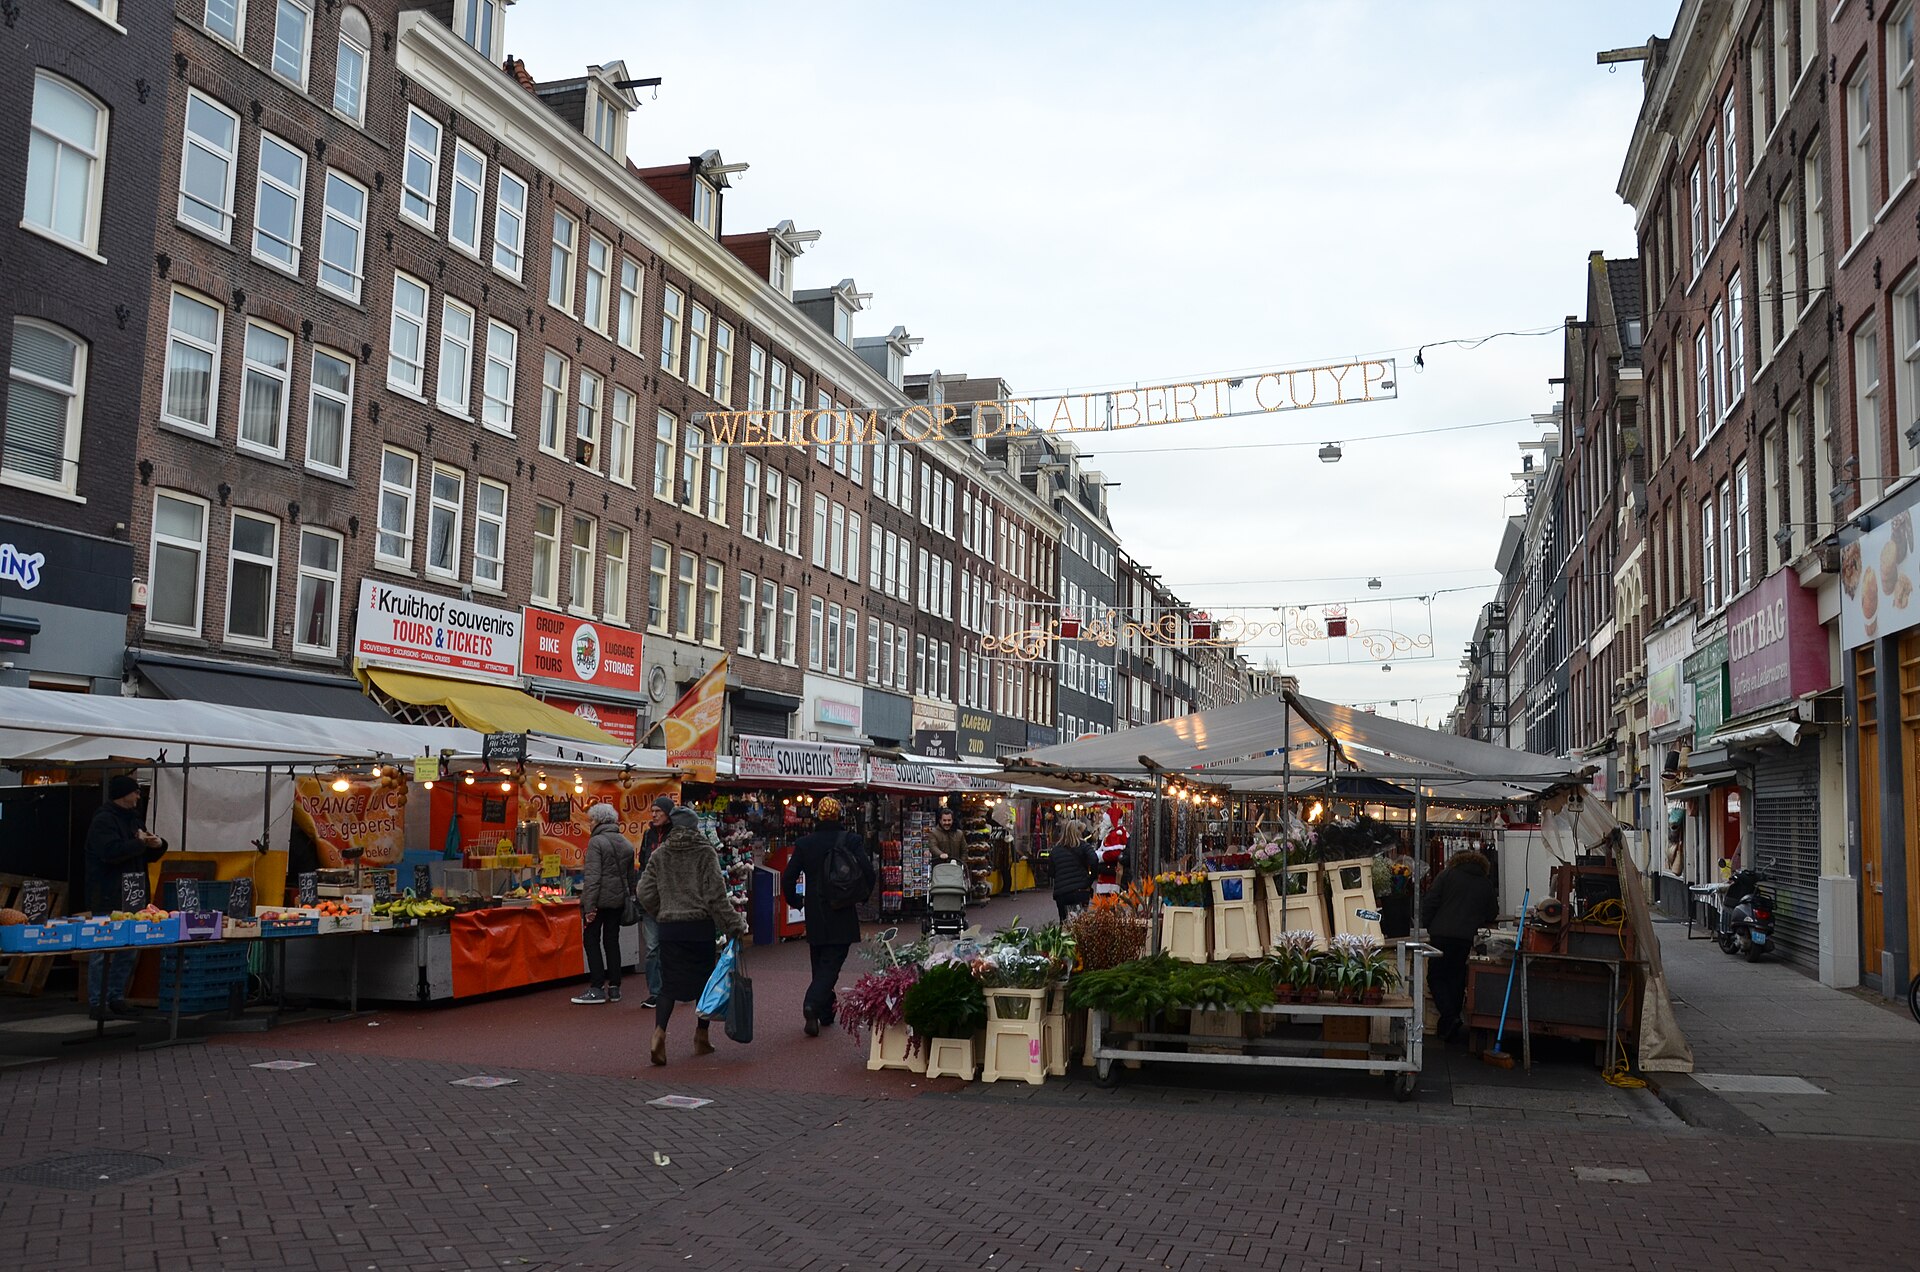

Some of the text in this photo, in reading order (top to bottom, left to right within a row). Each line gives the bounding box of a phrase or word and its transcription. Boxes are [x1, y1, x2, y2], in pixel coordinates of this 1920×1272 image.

[705, 360, 1386, 446] WELKOM OP DE ALBERT CUYP
[379, 588, 515, 638] Kruithof souvenirs
[536, 616, 564, 635] GROUP
[1731, 614, 1756, 663] CITY
[1758, 597, 1787, 651] BAG
[393, 619, 493, 657] TOURS & TICKETS
[539, 636, 560, 654] BIKE
[363, 643, 391, 655] SOUVENIRS
[604, 641, 635, 659] LUGGAGE
[534, 654, 563, 673] TOURS
[603, 659, 635, 677] STORAGE
[961, 713, 992, 732] SLAGERIJ
[926, 746, 938, 756] Pho
[968, 738, 984, 754] ZUID
[744, 738, 775, 759] Kruithof
[777, 745, 833, 776] souvenirs
[836, 747, 860, 765] Kruithof
[302, 796, 365, 814] ORANGE
[341, 815, 397, 841] geperst
[541, 821, 582, 836] vers
[365, 845, 392, 859] beker
